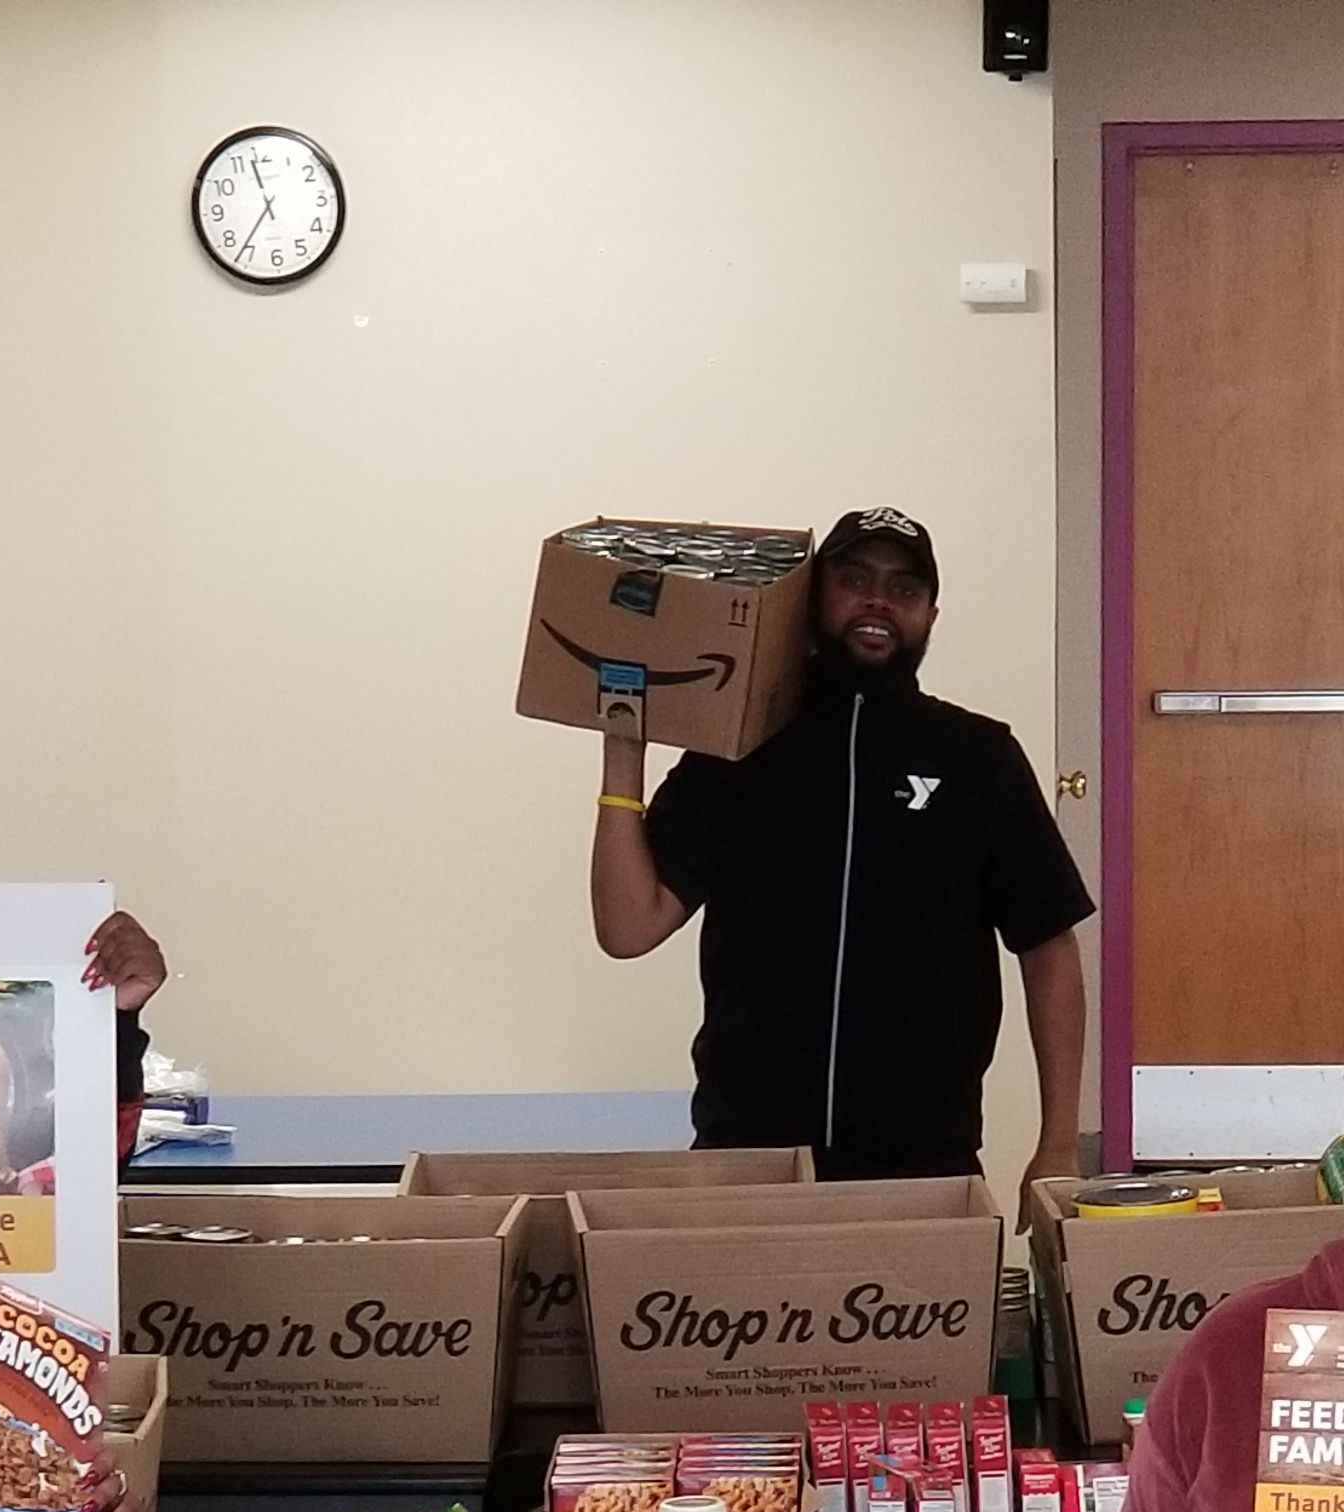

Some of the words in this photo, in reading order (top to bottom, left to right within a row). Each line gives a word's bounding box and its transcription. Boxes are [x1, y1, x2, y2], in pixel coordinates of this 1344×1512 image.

[230, 155, 245, 174] 11
[302, 165, 317, 183] 2
[214, 178, 235, 197] 10
[316, 190, 328, 208] 3
[211, 204, 224, 222] 9
[310, 217, 323, 234] 4
[223, 230, 237, 248] 8
[294, 238, 308, 257] 5
[270, 248, 284, 267] 6
[827, 1282, 970, 1344] Save
[329, 1299, 473, 1360] Save
[706, 1368, 750, 1381] Smart
[754, 1366, 818, 1382] Shoppers
[208, 1379, 251, 1391] Smart
[256, 1378, 319, 1394] Shoppers
[655, 1386, 679, 1399] The
[684, 1385, 720, 1398] More
[724, 1384, 752, 1397] You
[800, 1382, 825, 1394] The
[828, 1380, 866, 1393] More
[870, 1377, 897, 1391] You
[900, 1375, 937, 1390] Save!
[301, 1395, 324, 1407] The
